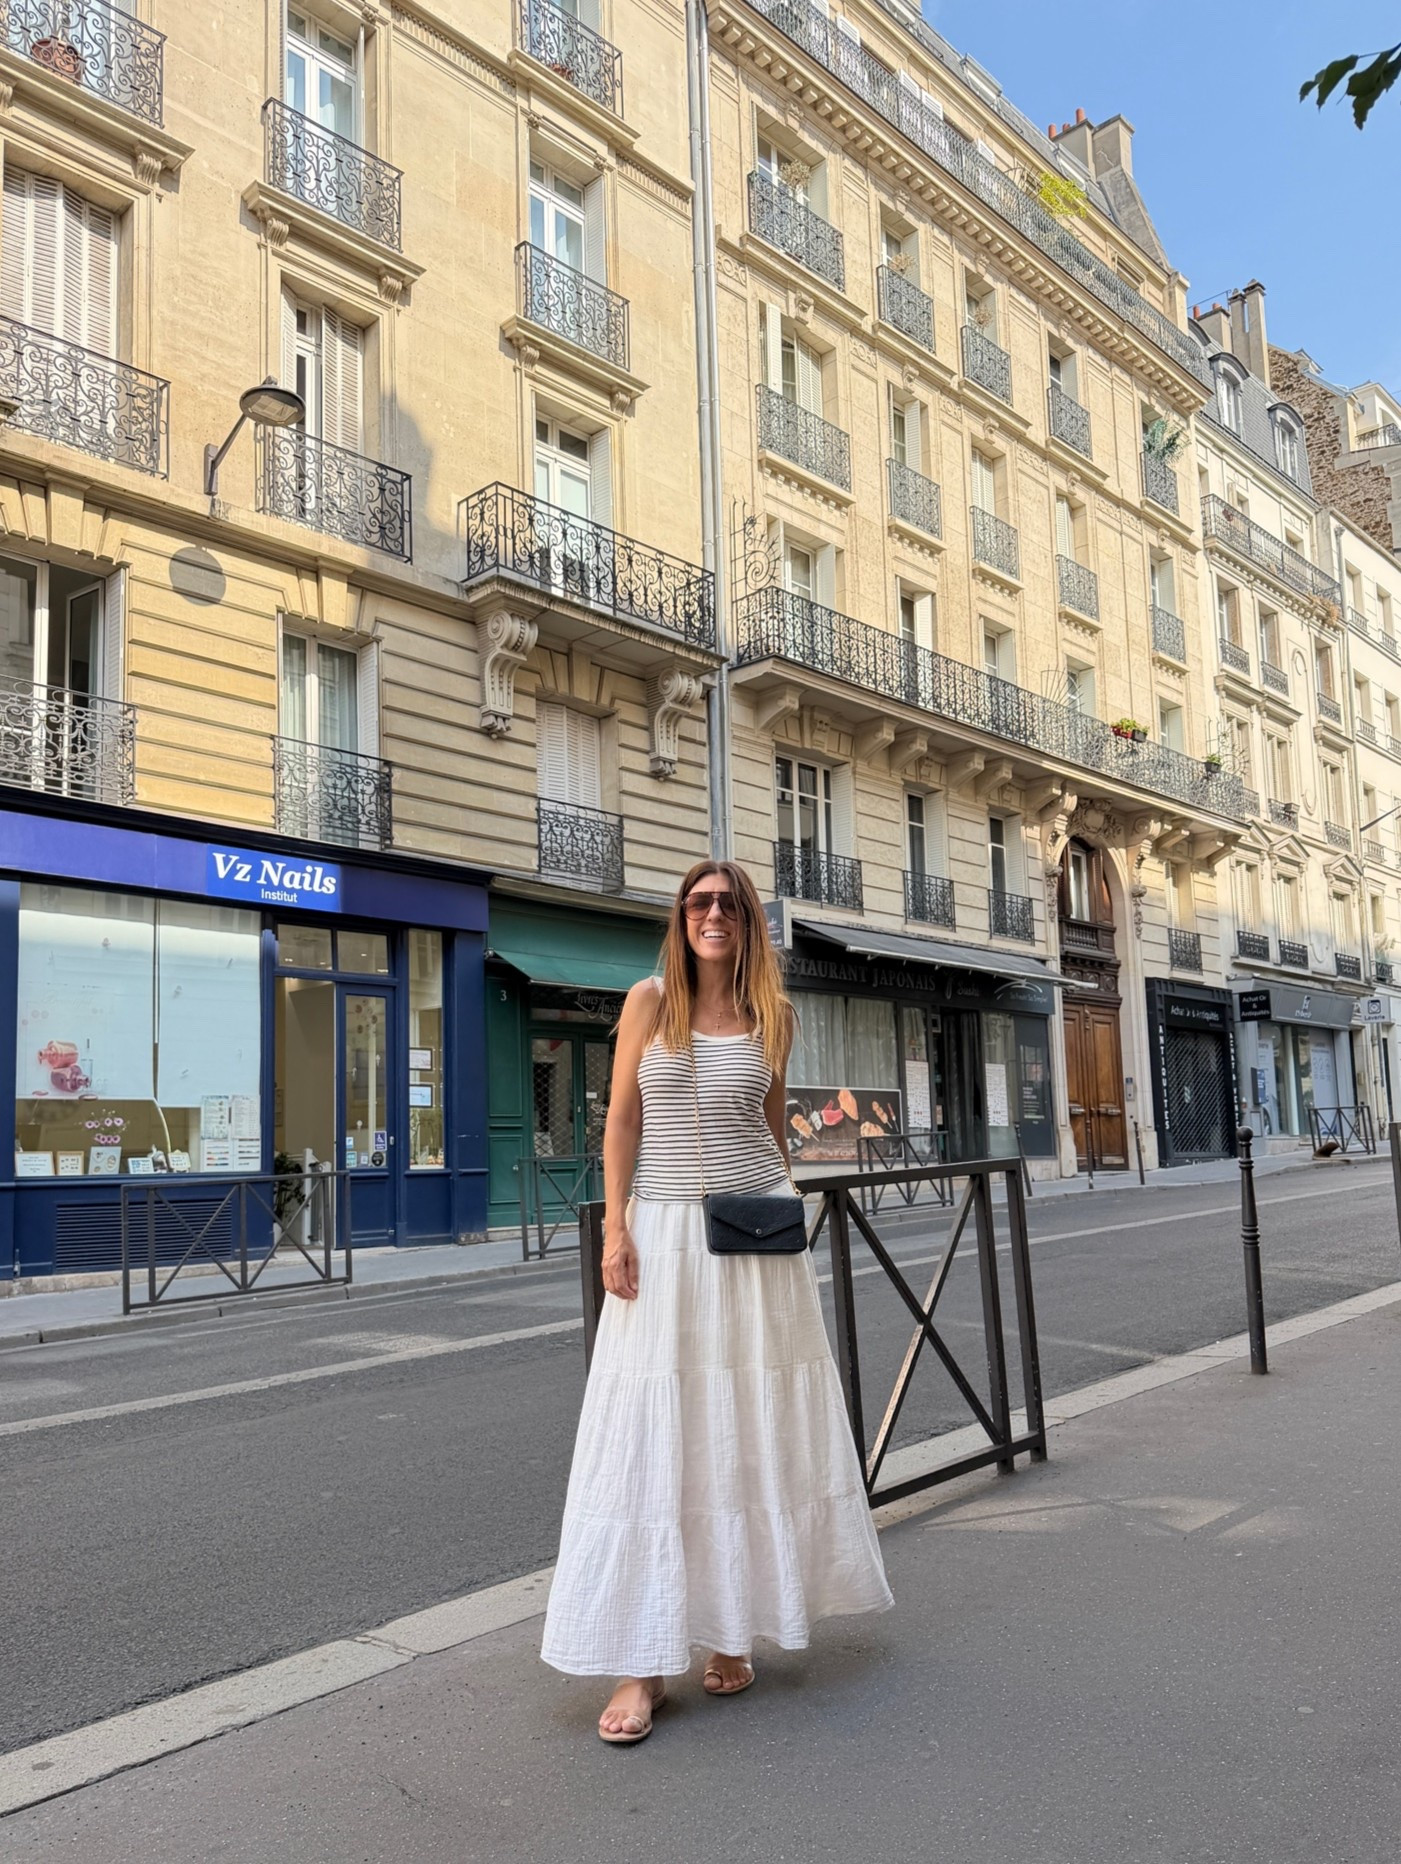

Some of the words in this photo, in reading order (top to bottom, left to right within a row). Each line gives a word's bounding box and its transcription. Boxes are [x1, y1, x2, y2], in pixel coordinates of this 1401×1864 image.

[212, 852, 252, 882] Vz
[256, 860, 337, 894] Nails
[261, 888, 298, 903] Institut
[872, 967, 936, 992] JAPONAIS
[500, 989, 507, 1001] 3
